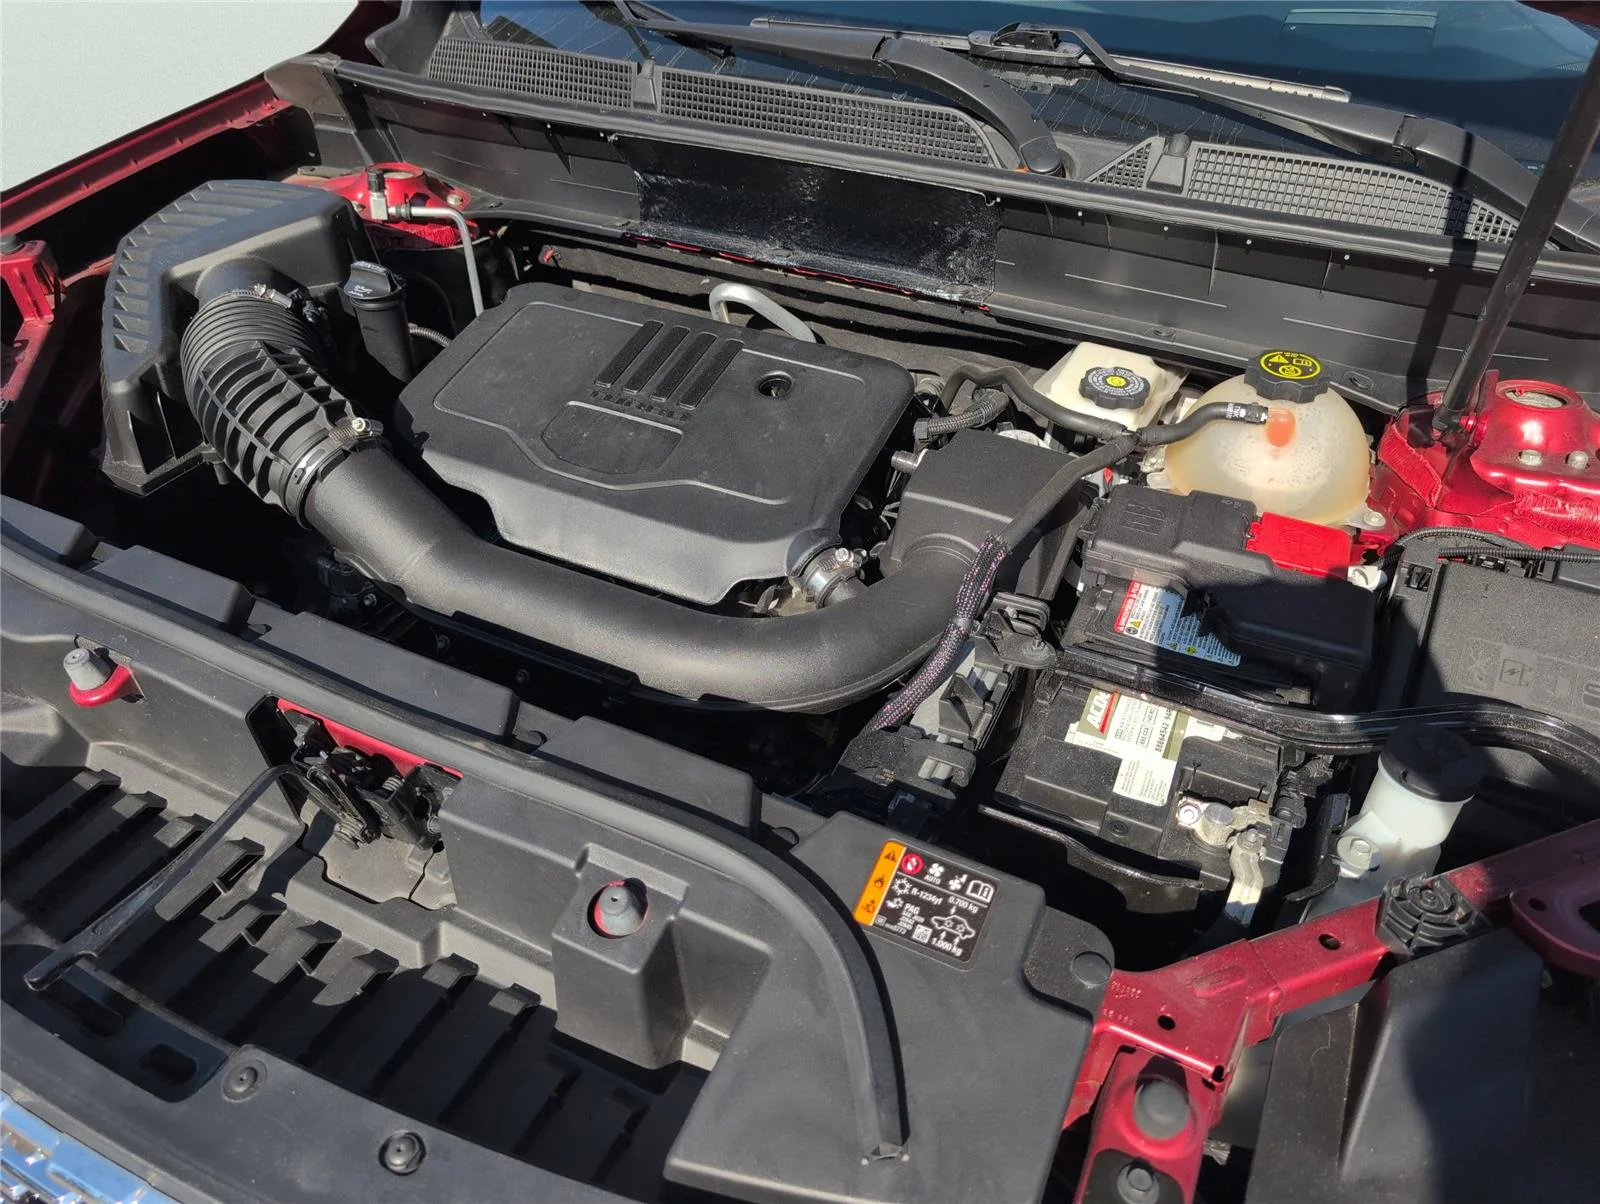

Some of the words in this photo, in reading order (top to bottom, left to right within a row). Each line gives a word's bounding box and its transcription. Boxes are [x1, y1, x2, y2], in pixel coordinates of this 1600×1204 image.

[924, 875, 941, 885] AUTO
[910, 887, 943, 905] R-1234yf
[904, 903, 921, 915] PAG
[948, 896, 969, 909] 0.700
[968, 903, 979, 915] kg
[931, 937, 952, 952] 1.000
[952, 945, 963, 957] kg
